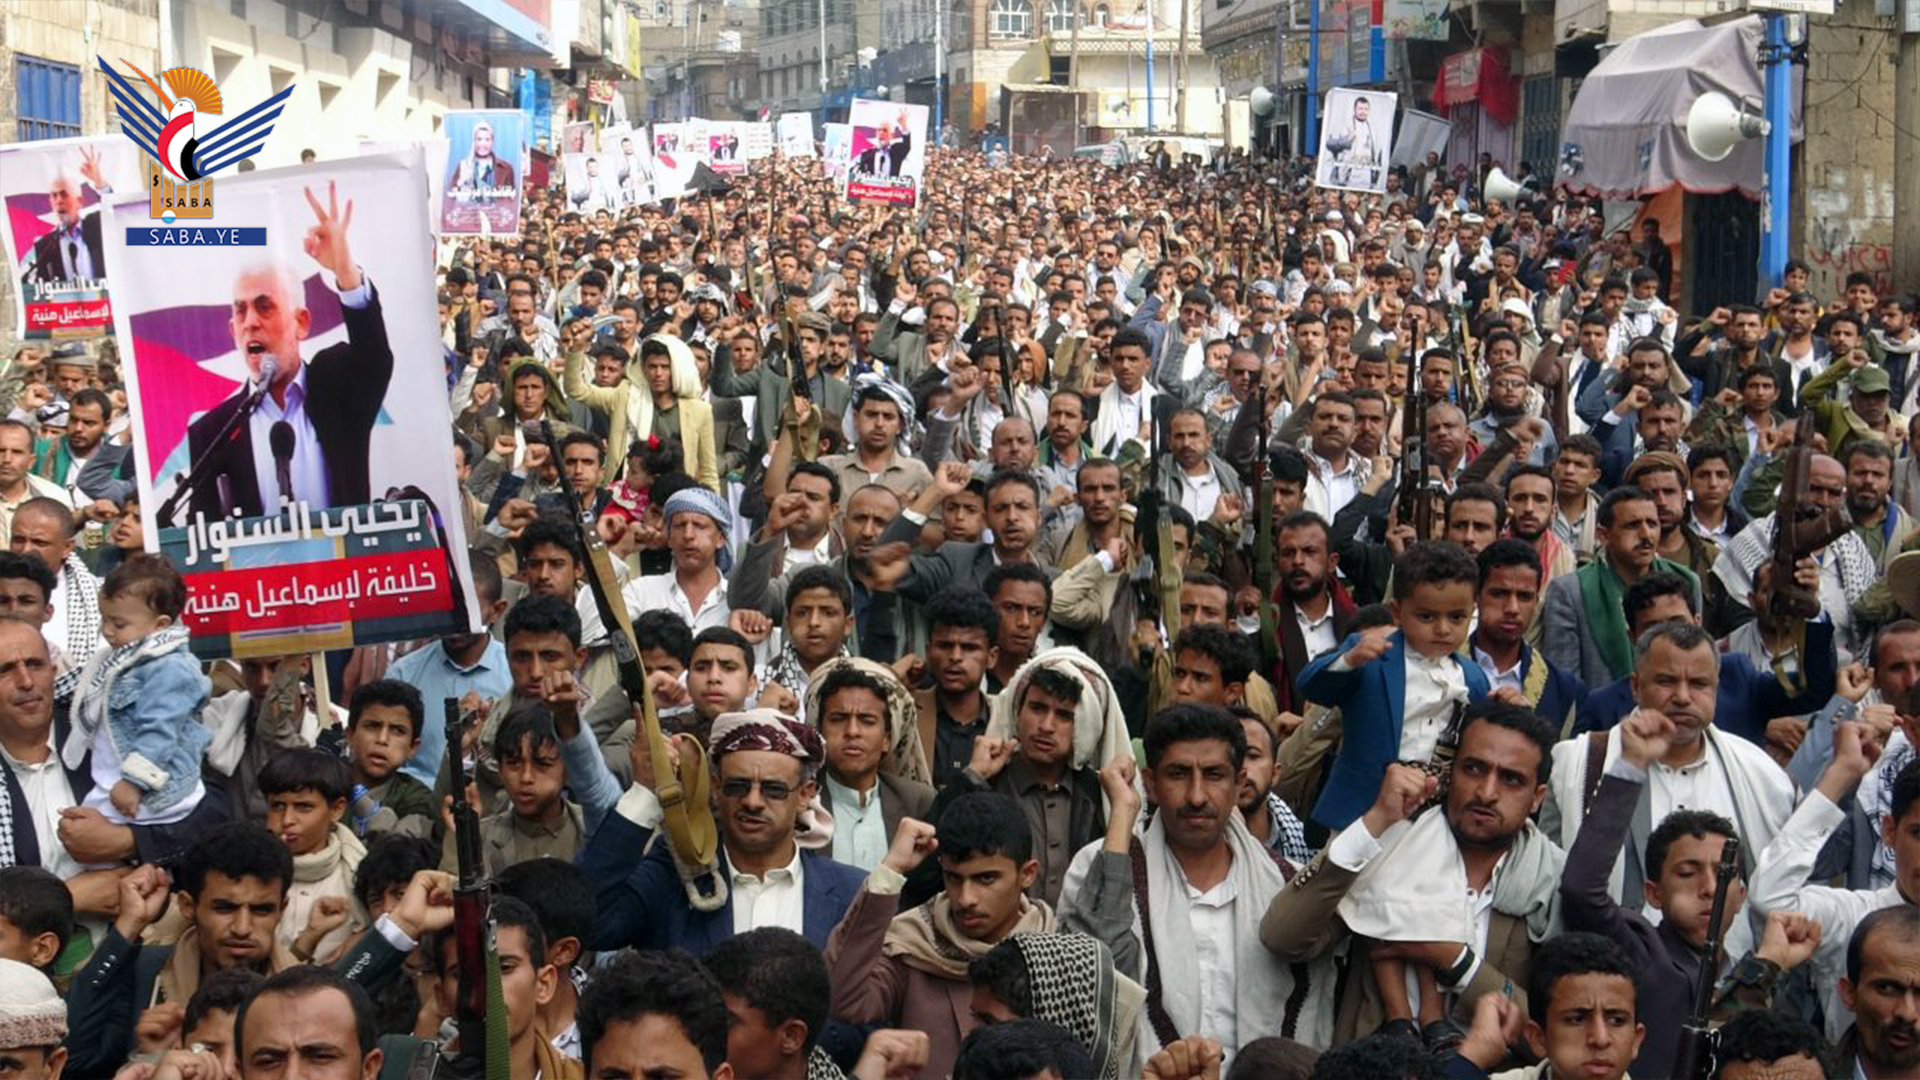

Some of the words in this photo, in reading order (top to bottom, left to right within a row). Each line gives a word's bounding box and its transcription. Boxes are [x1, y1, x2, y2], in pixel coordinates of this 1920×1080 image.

[34, 275, 85, 300] السنوار
[32, 308, 58, 325] هنية
[185, 501, 313, 566] السنوار
[322, 500, 421, 547] يحيى
[184, 585, 241, 622] هنية
[246, 570, 361, 618] لإسماعيل
[366, 562, 436, 604] خليفة
